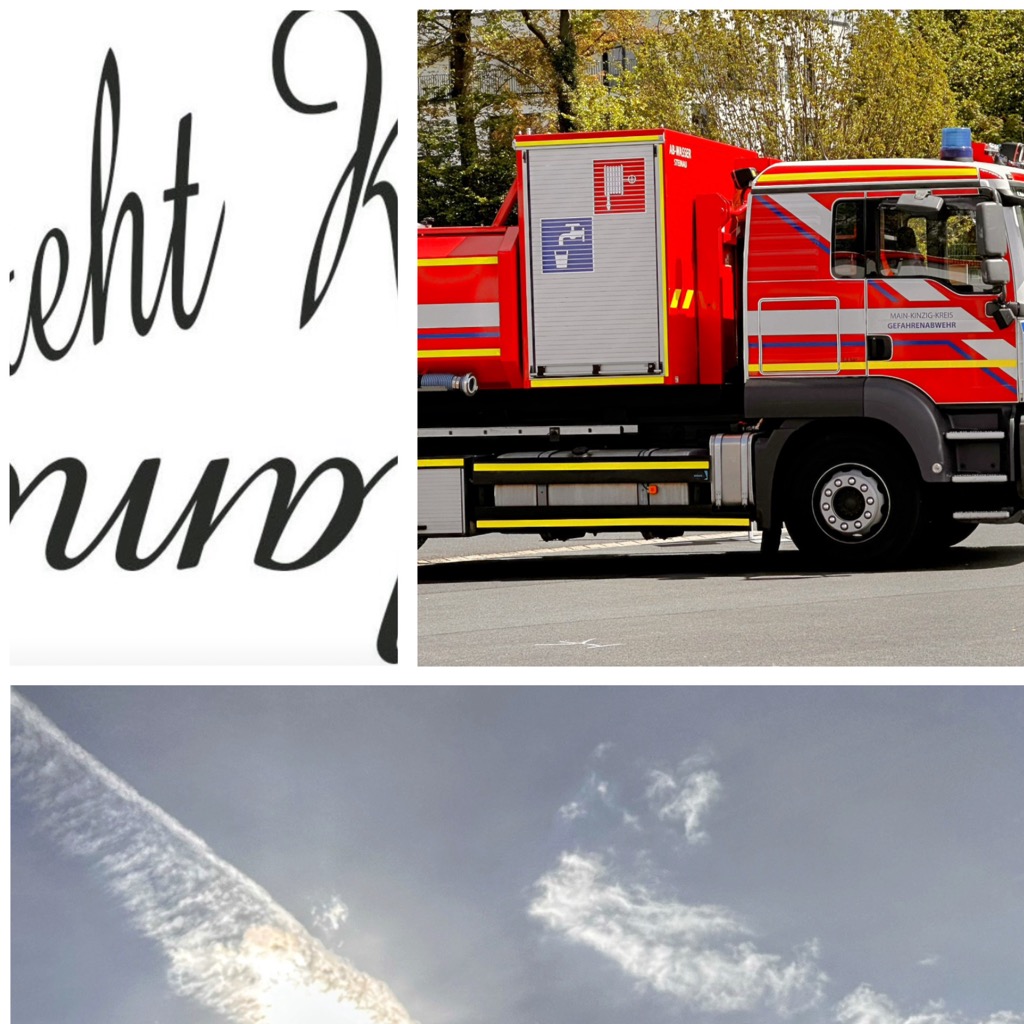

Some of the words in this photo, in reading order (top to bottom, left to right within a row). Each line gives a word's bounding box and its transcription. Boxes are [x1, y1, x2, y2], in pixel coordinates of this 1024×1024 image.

[10, 47, 226, 376] eht
[890, 311, 954, 320] MAIN-KINZIG-KREIS
[887, 321, 957, 330] GEFAHRENABWEHR
